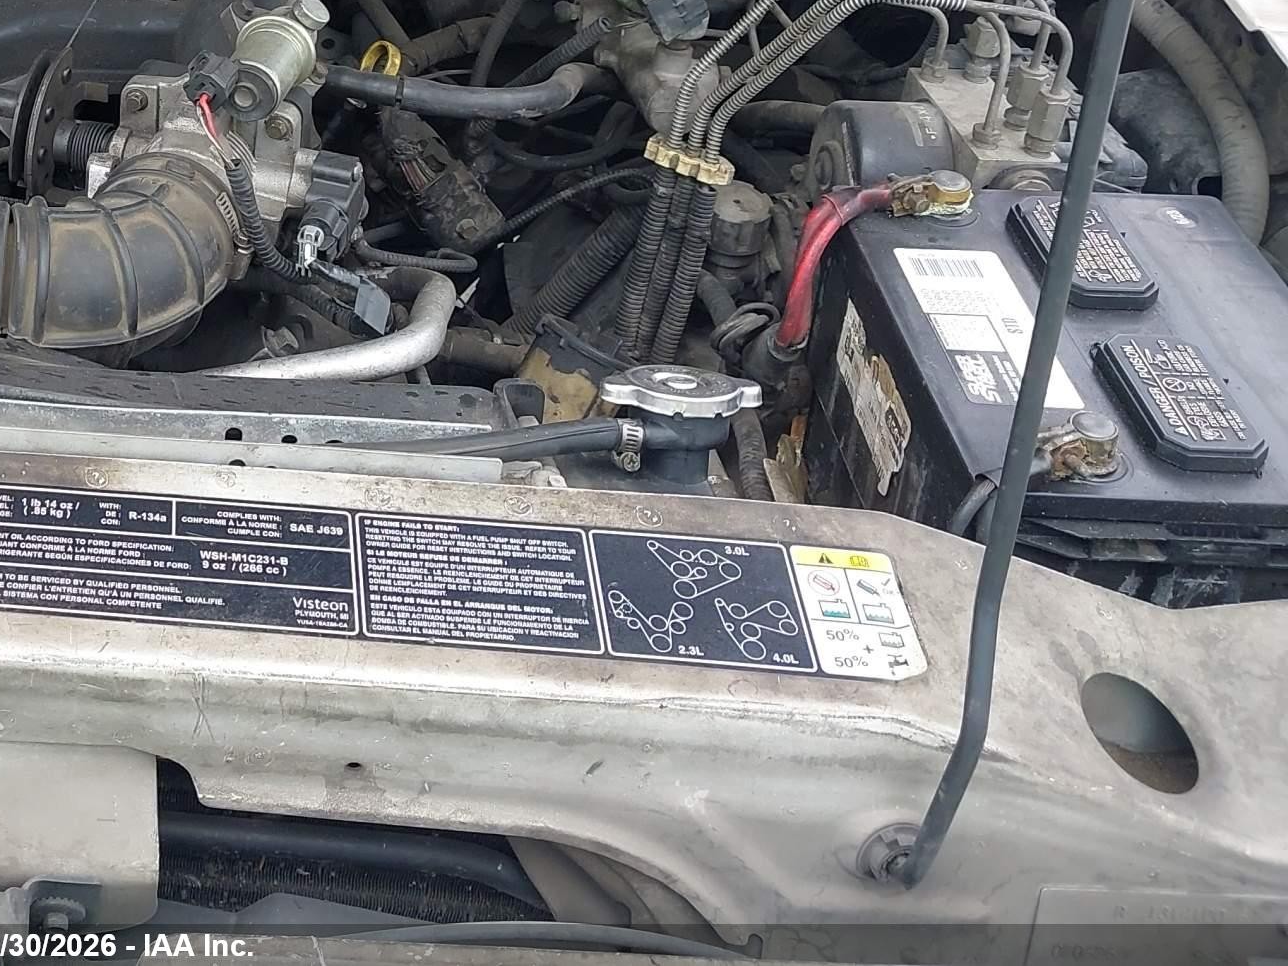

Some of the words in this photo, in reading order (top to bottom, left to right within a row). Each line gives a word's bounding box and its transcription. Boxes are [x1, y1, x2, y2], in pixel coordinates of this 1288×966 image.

[1120, 345, 1152, 379] POISON
[1148, 386, 1185, 426] DANGER
[30, 498, 41, 507] lb
[41, 499, 56, 508] 14
[59, 500, 73, 510] oz
[30, 506, 46, 517] .85
[49, 507, 63, 518] kg
[128, 511, 166, 522] R-134a
[217, 510, 257, 520] COMPLIES
[259, 513, 281, 522] WITH:
[181, 515, 226, 526] CONFORME
[236, 519, 246, 527] LA
[248, 520, 277, 529] NORME
[290, 522, 313, 533] SAE
[316, 524, 343, 535] J639
[372, 520, 399, 528] ENGINE
[434, 524, 459, 532] START:
[227, 527, 259, 536] CUMPLE
[262, 530, 281, 538] CON:
[10, 533, 24, 541] OIL
[25, 534, 73, 544] ACCORDING
[75, 537, 85, 545] TO
[87, 538, 109, 547] FORD
[19, 541, 65, 552] CONFORME
[75, 545, 85, 553] LA
[87, 546, 116, 556] NORME
[118, 548, 140, 557] FORD
[724, 546, 750, 556] 3.0L
[74, 553, 151, 566] ESPECIFICACIONES
[153, 559, 164, 567] DE
[200, 550, 288, 565] WSH-M1C231-B
[212, 561, 225, 571] oz
[266, 565, 279, 575] cc
[4, 573, 15, 581] TO
[17, 574, 28, 582] BE
[30, 575, 71, 585] SERVICED
[73, 578, 84, 586] BY
[86, 579, 128, 589] QUALIFIED
[131, 582, 182, 593] PERSONNEL.
[6, 581, 42, 591] CONFIER
[44, 584, 95, 595] L'ENTRETIEN
[120, 590, 131, 598] UN
[133, 591, 183, 602] PERSONNEL
[2, 590, 38, 600] SISTEMA
[40, 592, 58, 601] CON
[60, 594, 104, 605] PERSONAL
[106, 597, 161, 609] COMPETENTE
[292, 597, 348, 612] Visteon
[295, 609, 338, 620] PLYMOUTH,
[340, 613, 348, 621] MI
[825, 628, 860, 642] 50%
[678, 645, 704, 656] 2.3L
[772, 653, 799, 664] 4.0L
[834, 655, 869, 668] 50%
